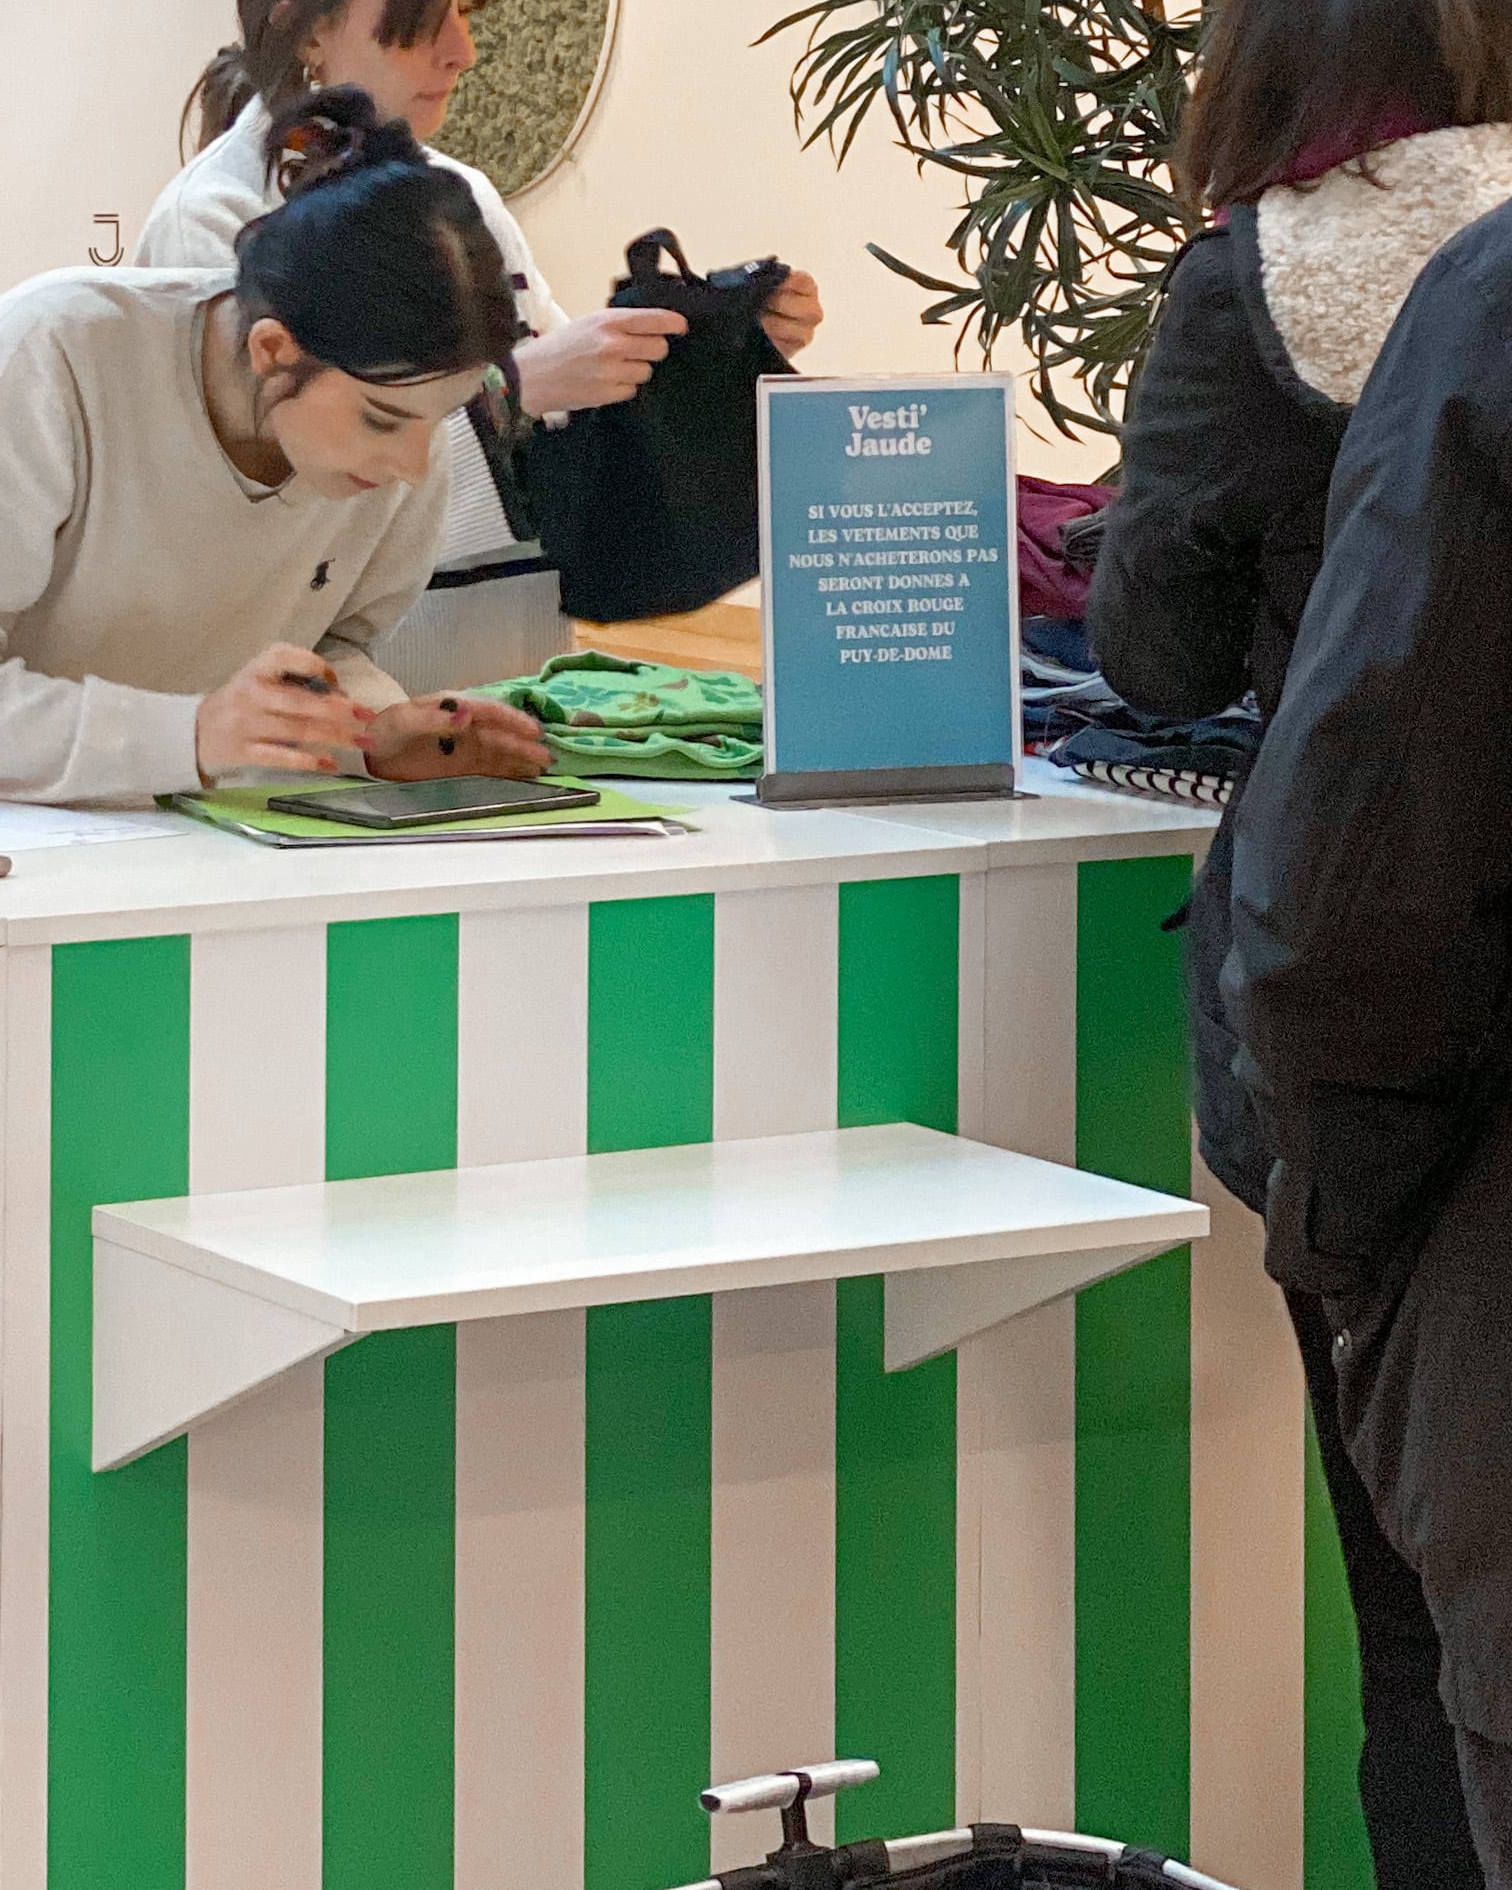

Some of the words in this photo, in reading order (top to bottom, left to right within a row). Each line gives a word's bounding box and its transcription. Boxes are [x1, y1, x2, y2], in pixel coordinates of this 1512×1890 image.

[845, 432, 931, 456] Jaude
[809, 505, 824, 519] SI
[829, 504, 873, 518] VOUS
[808, 530, 837, 543] LES
[842, 526, 940, 542] VETEMENTS
[945, 525, 978, 541] QUE
[789, 554, 834, 568] NOUS
[967, 548, 998, 562] PAS
[818, 576, 883, 591] SERONT
[888, 574, 954, 589] DONNES
[827, 602, 847, 616] LA
[852, 600, 903, 614] CROIX
[908, 597, 964, 612] ROUGE
[836, 623, 928, 639] FRANCAISE
[932, 622, 955, 635] DU
[841, 646, 952, 663] PUY-DE-DOME
